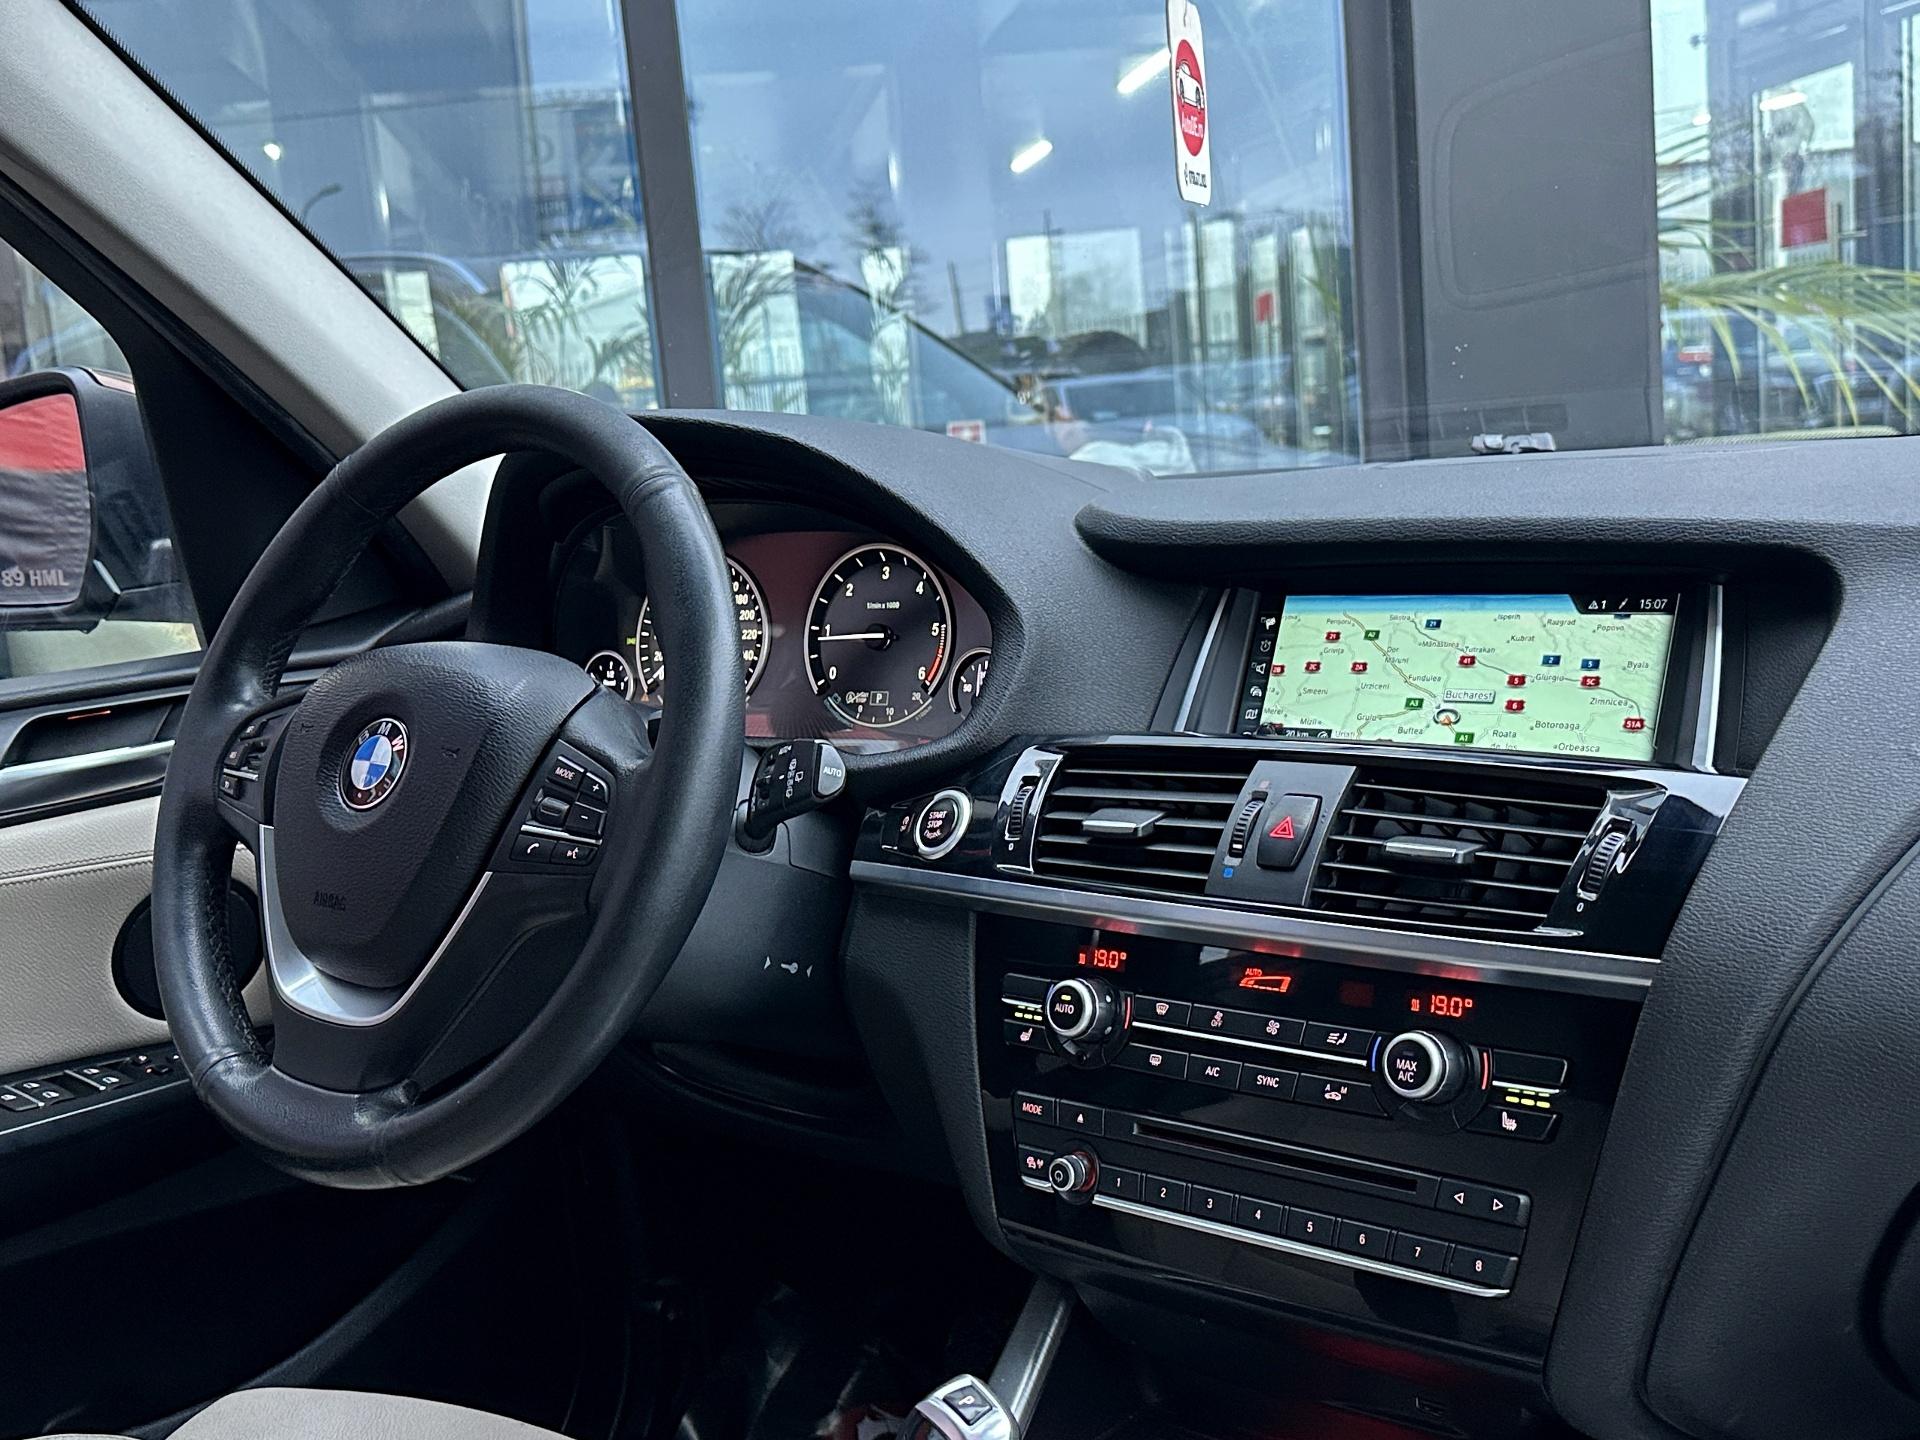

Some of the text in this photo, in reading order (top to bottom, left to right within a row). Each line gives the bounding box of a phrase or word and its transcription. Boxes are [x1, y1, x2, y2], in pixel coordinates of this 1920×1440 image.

[1, 568, 70, 587] 89 HML
[881, 566, 890, 580] 3
[845, 583, 853, 597] 2
[915, 581, 924, 595] 4
[735, 593, 749, 605] 180
[1601, 599, 1607, 610] 1
[1639, 598, 1668, 610] 15:07
[739, 609, 755, 621] 200
[1546, 618, 1576, 628] Razgrad
[741, 629, 758, 640] 220
[825, 624, 831, 637] 1
[931, 622, 939, 636] 5
[1510, 634, 1535, 643] Kubrat
[743, 649, 754, 661] 40
[1464, 645, 1496, 654] Tutrakan
[1627, 660, 1649, 670] Byala
[829, 666, 837, 680] 0
[918, 667, 926, 680] 6
[1408, 674, 1442, 683] Fundulea
[1303, 687, 1328, 695] Smeeni
[1360, 682, 1390, 690] Urziceni
[876, 693, 883, 704] P
[911, 692, 921, 701] 20
[1445, 690, 1494, 701] Bucharest
[1590, 696, 1628, 707] Zimnicea
[886, 707, 894, 716] 10
[1535, 720, 1580, 731] Botoroaga
[1625, 720, 1642, 730] 51A
[357, 721, 405, 752] BMW
[1285, 729, 1309, 738] 20 km
[1397, 726, 1424, 736] Buftea
[1492, 729, 1517, 739] Roata
[1558, 742, 1600, 753] Orbeasca
[554, 766, 576, 781] MODE
[823, 766, 842, 777] AUTO
[928, 810, 948, 820] START
[926, 819, 943, 829] STOP
[1576, 902, 1584, 912] 0
[1244, 967, 1263, 977] AUTO
[1054, 1002, 1075, 1015] AUTO
[1396, 1058, 1418, 1072] MAX
[1205, 1066, 1220, 1077] A/C
[1397, 1070, 1415, 1083] A/C
[1256, 1074, 1280, 1089] SYNC
[1324, 1084, 1331, 1092] A
[1340, 1086, 1348, 1095] M
[1022, 1101, 1043, 1116] MODE
[1116, 1178, 1121, 1188] 1
[1160, 1187, 1167, 1198] 2
[1207, 1198, 1213, 1209] 3
[1255, 1209, 1261, 1220] 4
[1307, 1221, 1313, 1232] 5
[1359, 1234, 1365, 1245] 6
[1415, 1247, 1421, 1258] 7
[1475, 1260, 1482, 1271] 8
